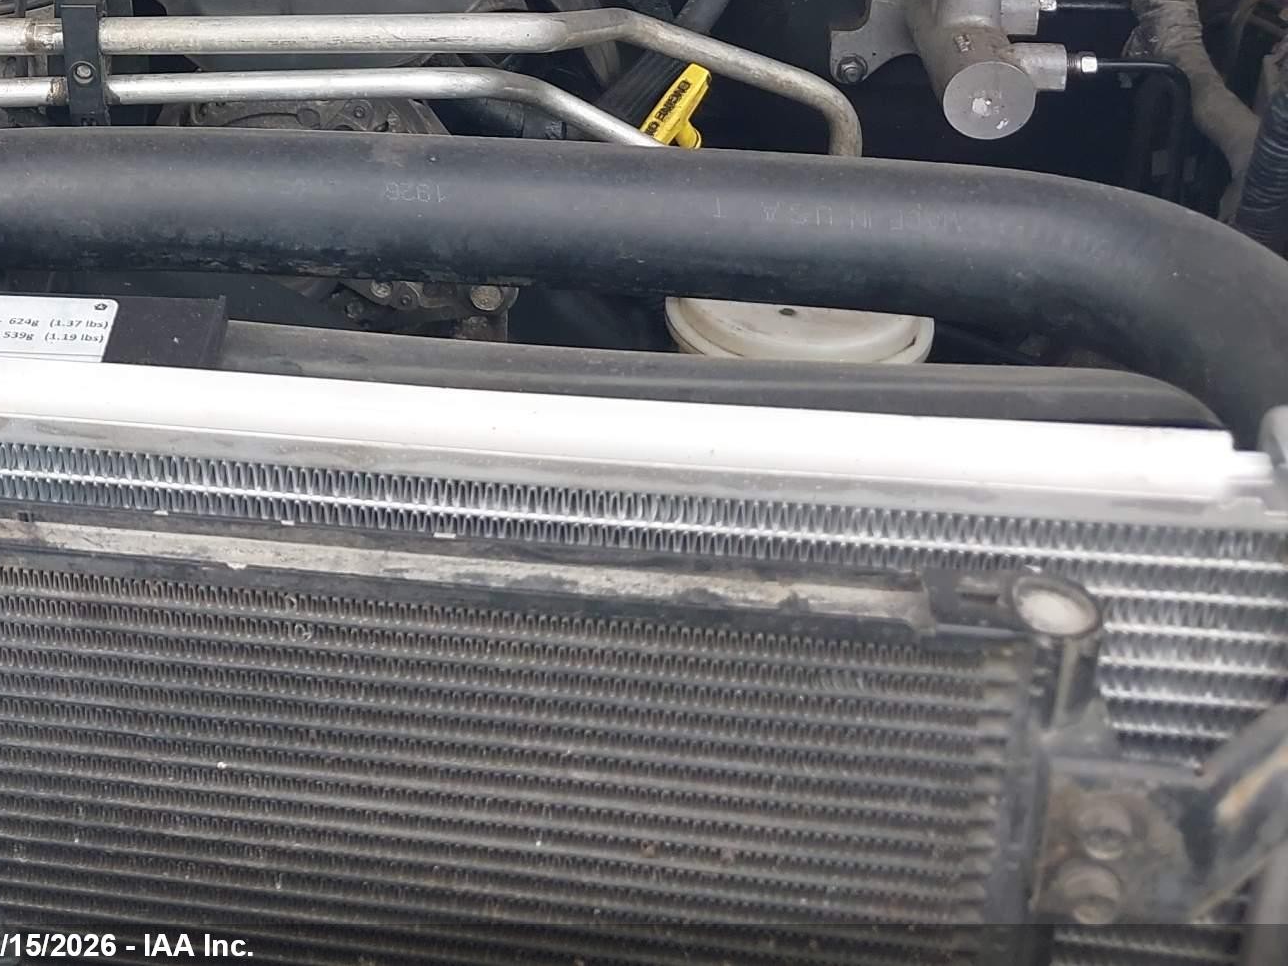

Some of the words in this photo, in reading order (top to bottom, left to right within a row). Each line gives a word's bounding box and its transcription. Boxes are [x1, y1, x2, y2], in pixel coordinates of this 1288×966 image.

[9, 317, 40, 327] 624g
[49, 319, 82, 328] (1.37
[85, 320, 109, 330] lbs)
[3, 331, 34, 341] 539g
[44, 332, 77, 342] (1.19
[80, 333, 104, 343] lbs)
